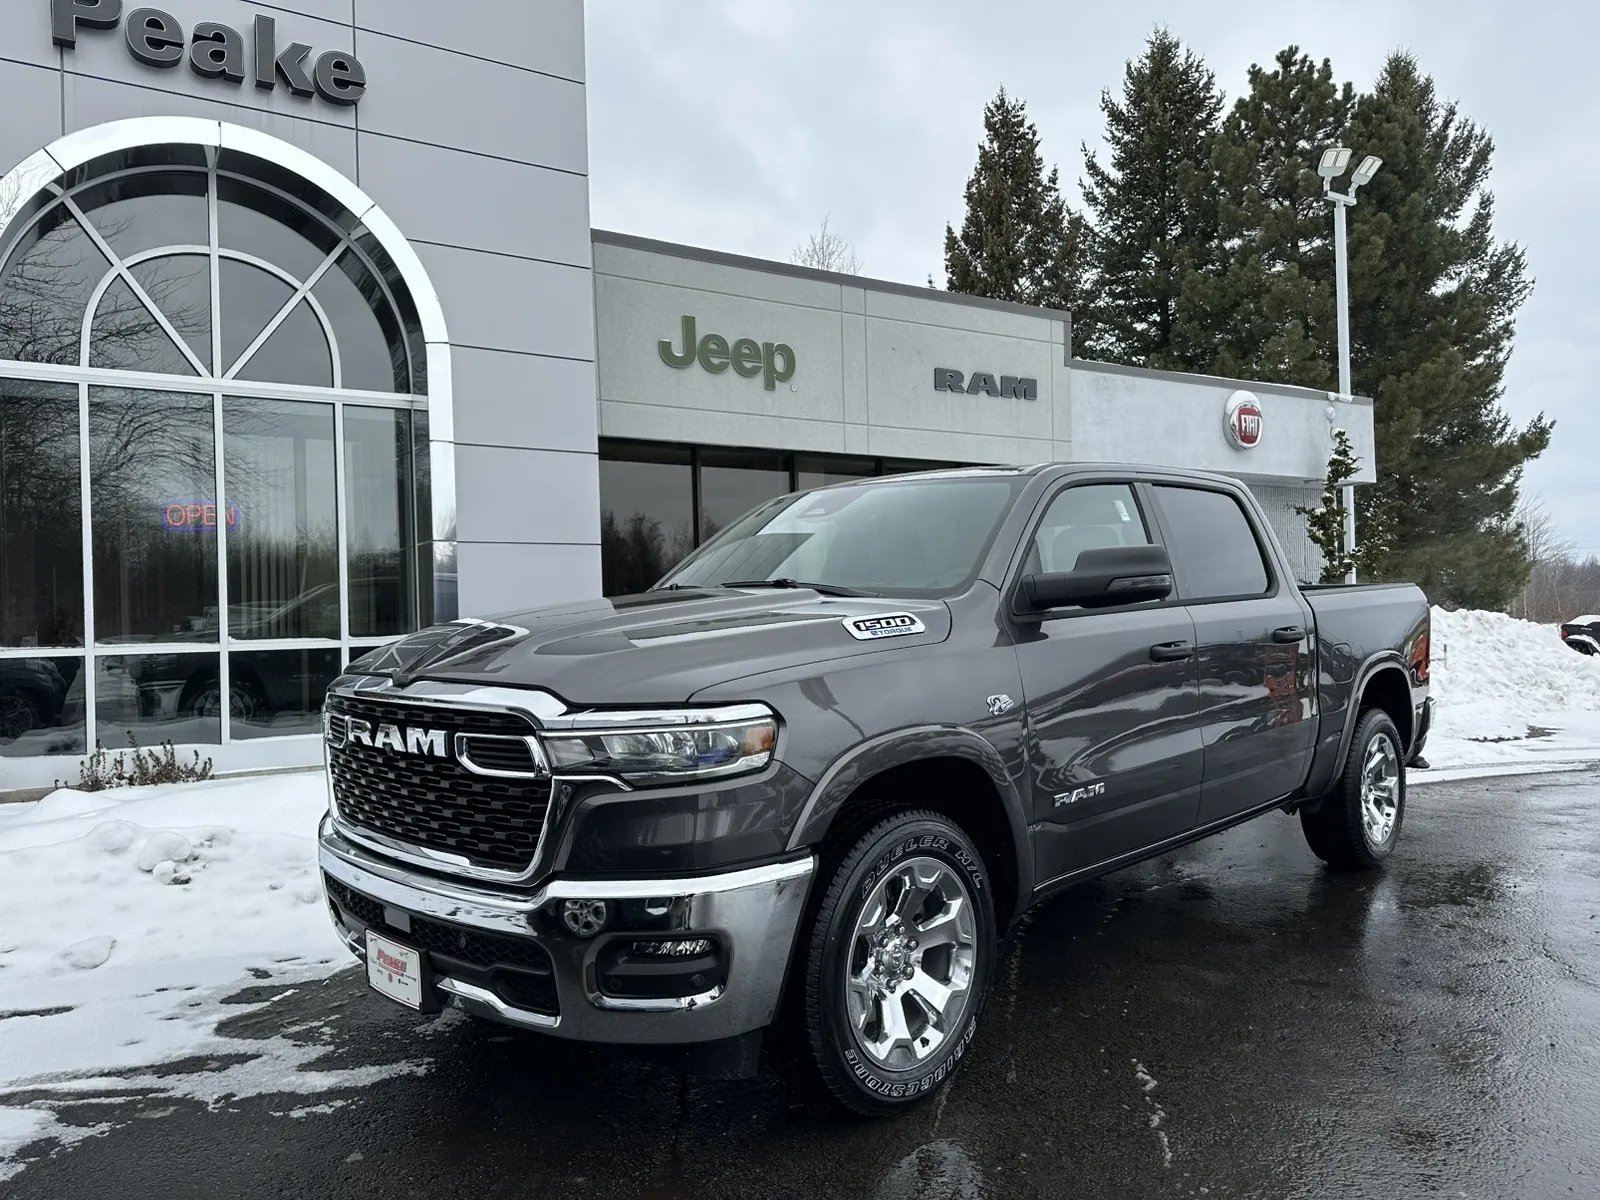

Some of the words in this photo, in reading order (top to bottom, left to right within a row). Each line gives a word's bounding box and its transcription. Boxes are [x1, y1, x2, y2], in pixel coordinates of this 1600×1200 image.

[51, 0, 367, 105] Peake
[658, 315, 796, 391] Jeep
[934, 368, 1037, 400] RAM
[1240, 414, 1259, 437] FIAT
[855, 616, 912, 631] 1500
[347, 716, 448, 758] RAM
[1053, 782, 1105, 807] RAM
[862, 835, 950, 899] DUELER
[845, 1015, 977, 1097] BRIDGESTONE
